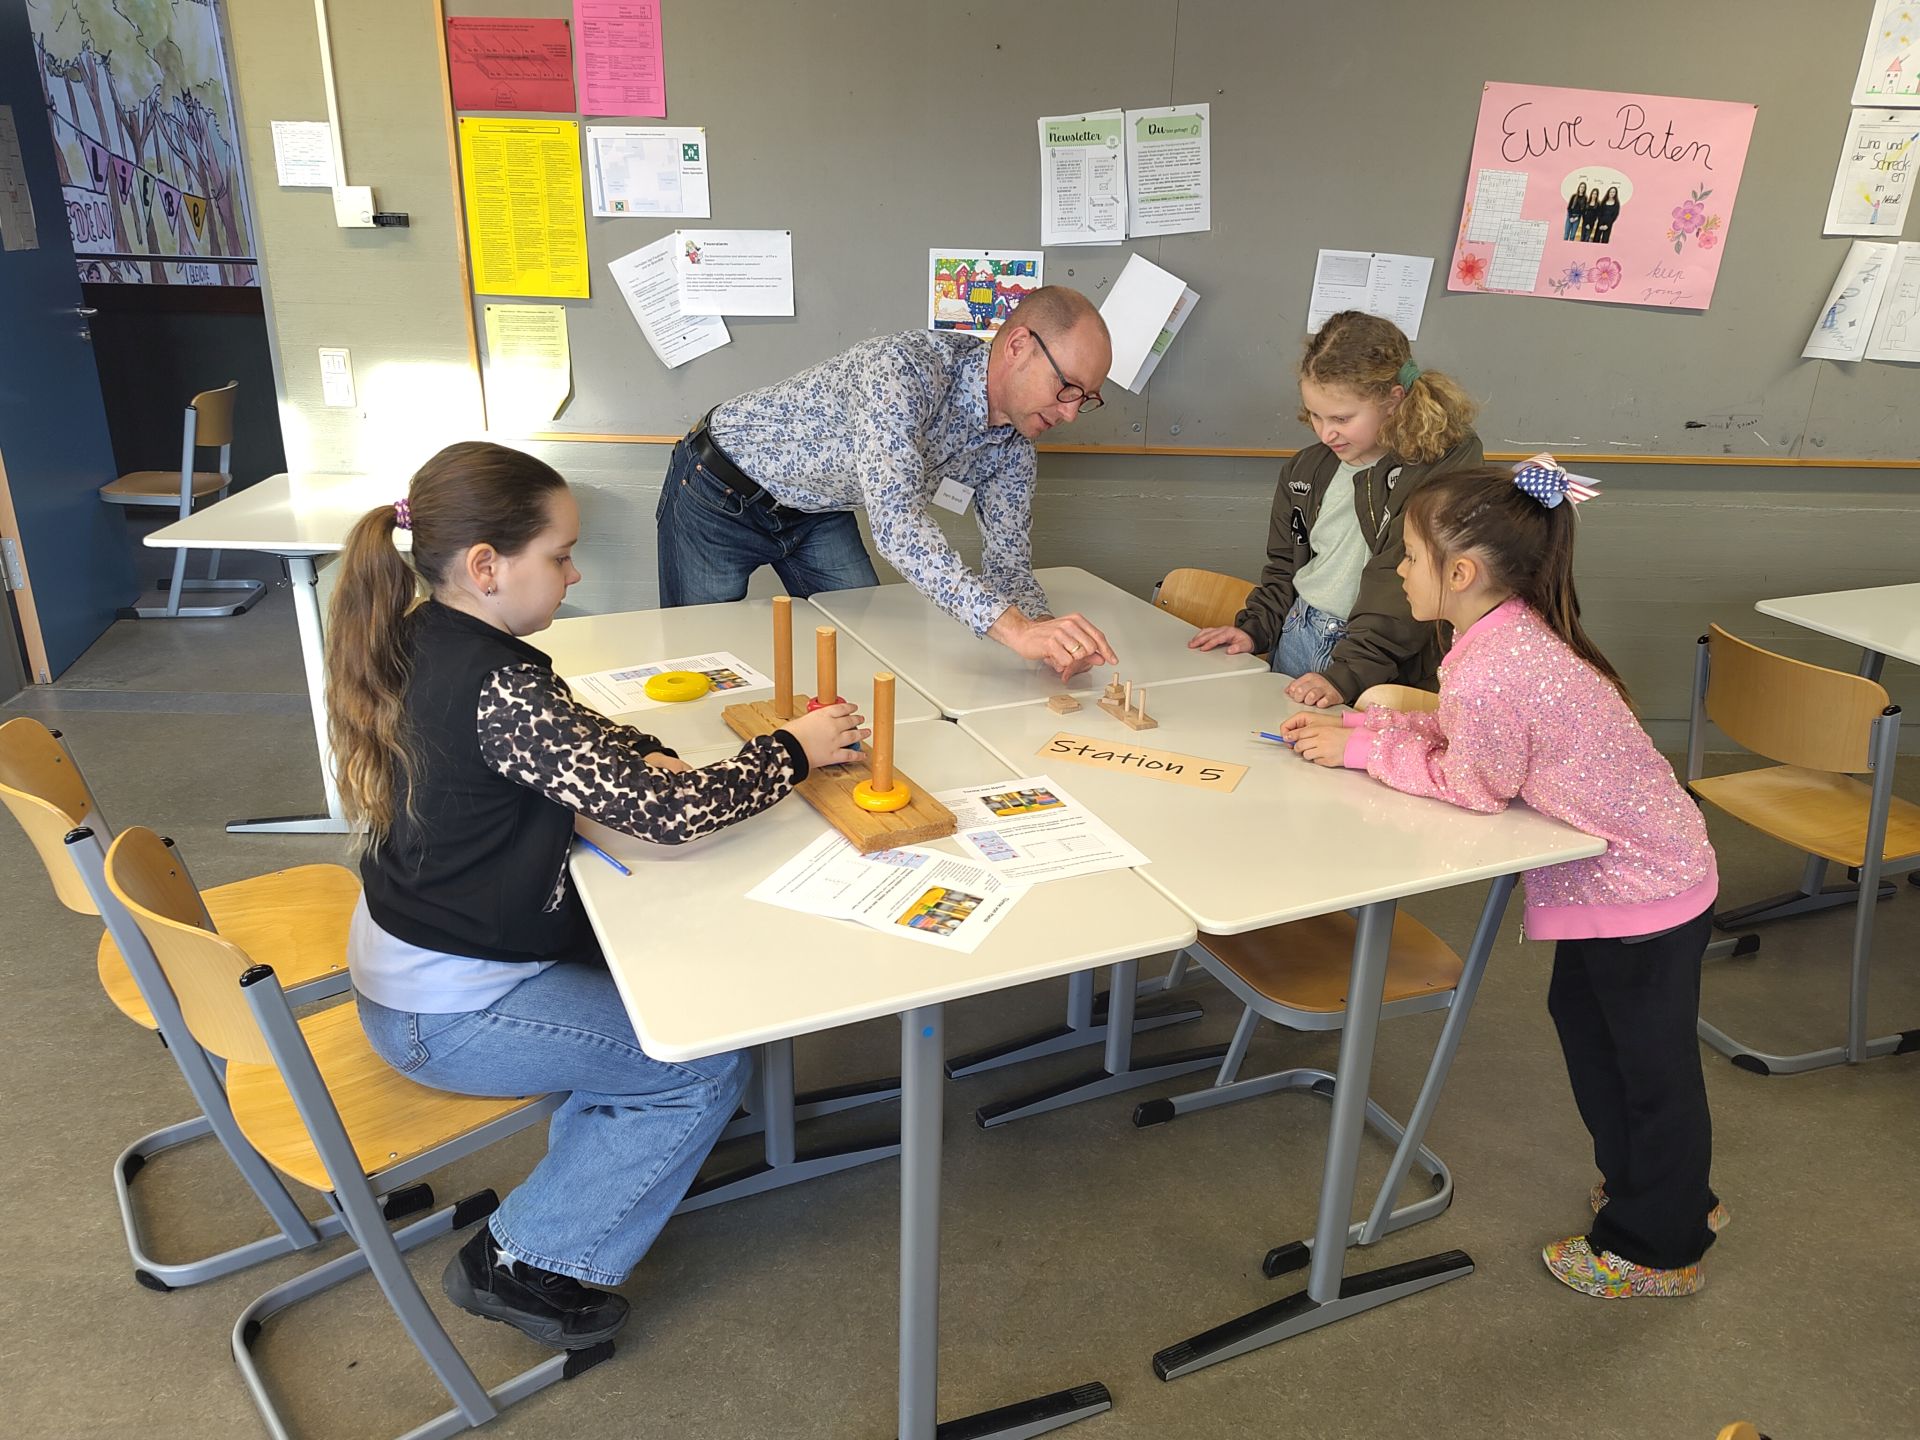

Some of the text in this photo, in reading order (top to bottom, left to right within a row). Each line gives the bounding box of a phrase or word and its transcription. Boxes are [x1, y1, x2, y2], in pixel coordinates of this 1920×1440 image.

[1148, 123, 1165, 135] Du
[1049, 131, 1101, 143] Newsletter
[1501, 102, 1713, 171] Eure Paten
[1886, 138, 1904, 151] und
[1049, 739, 1225, 781] Station 5
